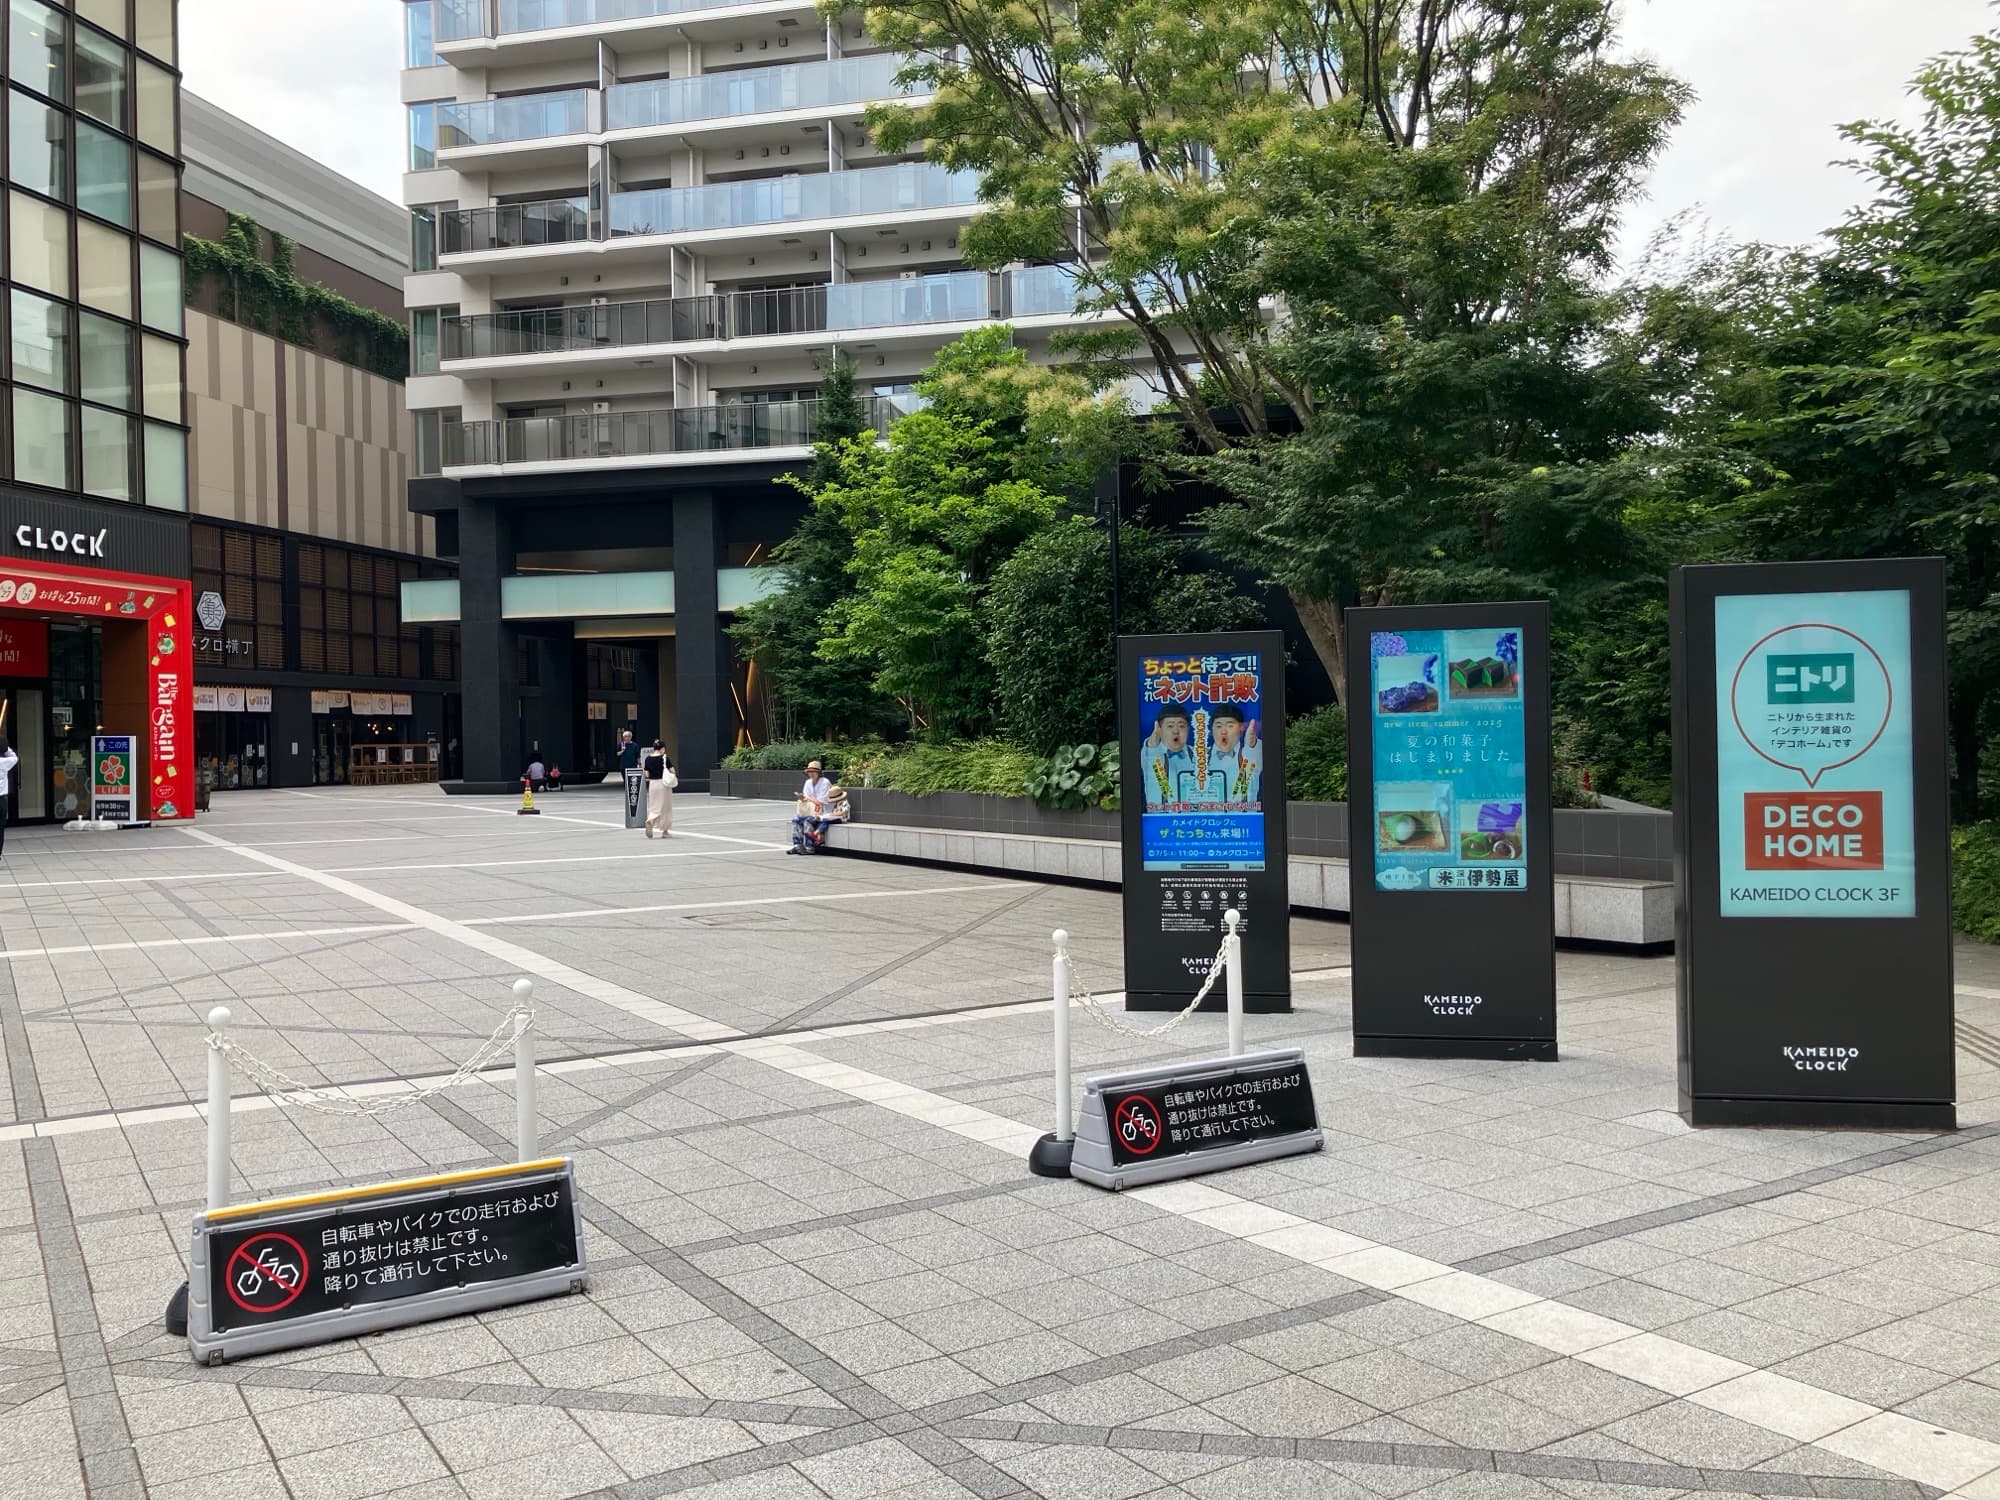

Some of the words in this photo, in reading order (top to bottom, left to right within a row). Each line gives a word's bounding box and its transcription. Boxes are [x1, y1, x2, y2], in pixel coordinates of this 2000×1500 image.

[16, 524, 107, 558] CLOCK
[1144, 656, 1257, 674] ちょっと待って!!
[1775, 665, 1847, 692] ニトリ
[1144, 678, 1153, 702] それ
[1154, 673, 1259, 703] ネット詐欺
[152, 673, 178, 761] Bargain
[1767, 711, 1856, 722] ニトリから生まれた
[1771, 725, 1852, 735] インテリア雑貨の
[1407, 734, 1492, 748] 夏の和菓子
[1771, 738, 1853, 749] 「デコホーム」です
[1390, 750, 1510, 763] はじまりました
[101, 785, 123, 793] LIFE
[1764, 804, 1863, 828] DECO
[1764, 834, 1863, 857] HOME
[1467, 869, 1519, 887] 伊勢屋
[1730, 887, 1810, 901] KAMEIDO
[1815, 887, 1874, 901] CLOCK
[1878, 887, 1900, 901] 3F
[1181, 957, 1217, 967] KAMEI
[1424, 995, 1482, 1006] KAMEIDO
[1433, 1004, 1474, 1015] CLOCK
[1783, 1046, 1859, 1060] KAMEIDO
[1795, 1057, 1849, 1071] CLOCK
[1164, 1073, 1301, 1108] 自転車やバイクでの走行および
[1167, 1099, 1262, 1126] 通り抜けは禁止です。
[1171, 1115, 1276, 1143] 降りて通行して下さい。
[321, 1190, 560, 1246] 自転車やバイクでの走行および
[322, 1232, 490, 1271] 通り抜けは禁止です。
[324, 1250, 509, 1294] 降りて通行して下さい。
